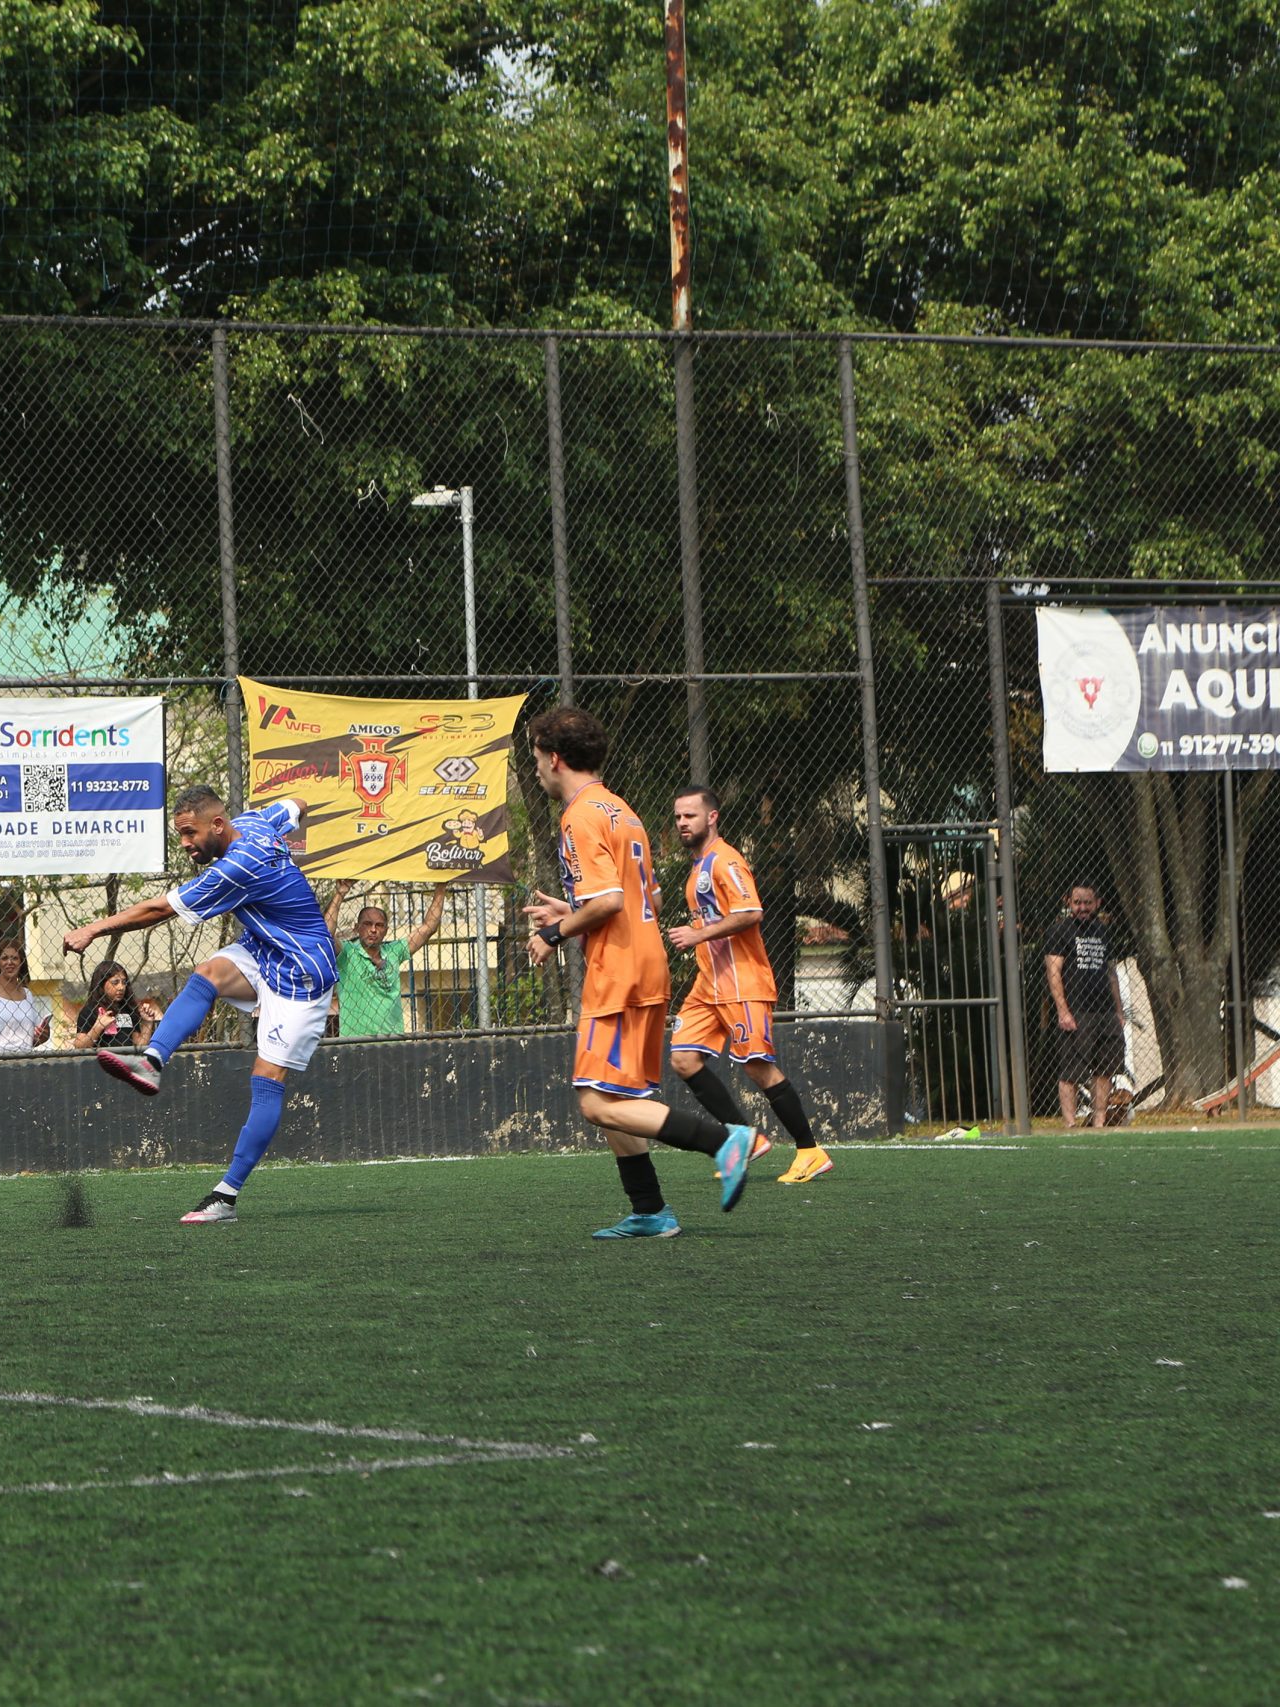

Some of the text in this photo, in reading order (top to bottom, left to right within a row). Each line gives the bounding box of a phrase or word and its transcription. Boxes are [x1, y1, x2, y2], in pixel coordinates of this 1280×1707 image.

[1138, 623, 1280, 654] ANUNCI
[1159, 668, 1280, 718] AQUI
[0, 722, 131, 747] Sorridents
[285, 721, 322, 735] WFG
[348, 724, 402, 737] AMIGOS
[0, 749, 132, 762] simples como sorrir
[1161, 741, 1174, 756] 11
[71, 780, 150, 795] 11 93232-8778
[52, 820, 145, 835] DEMARCHI
